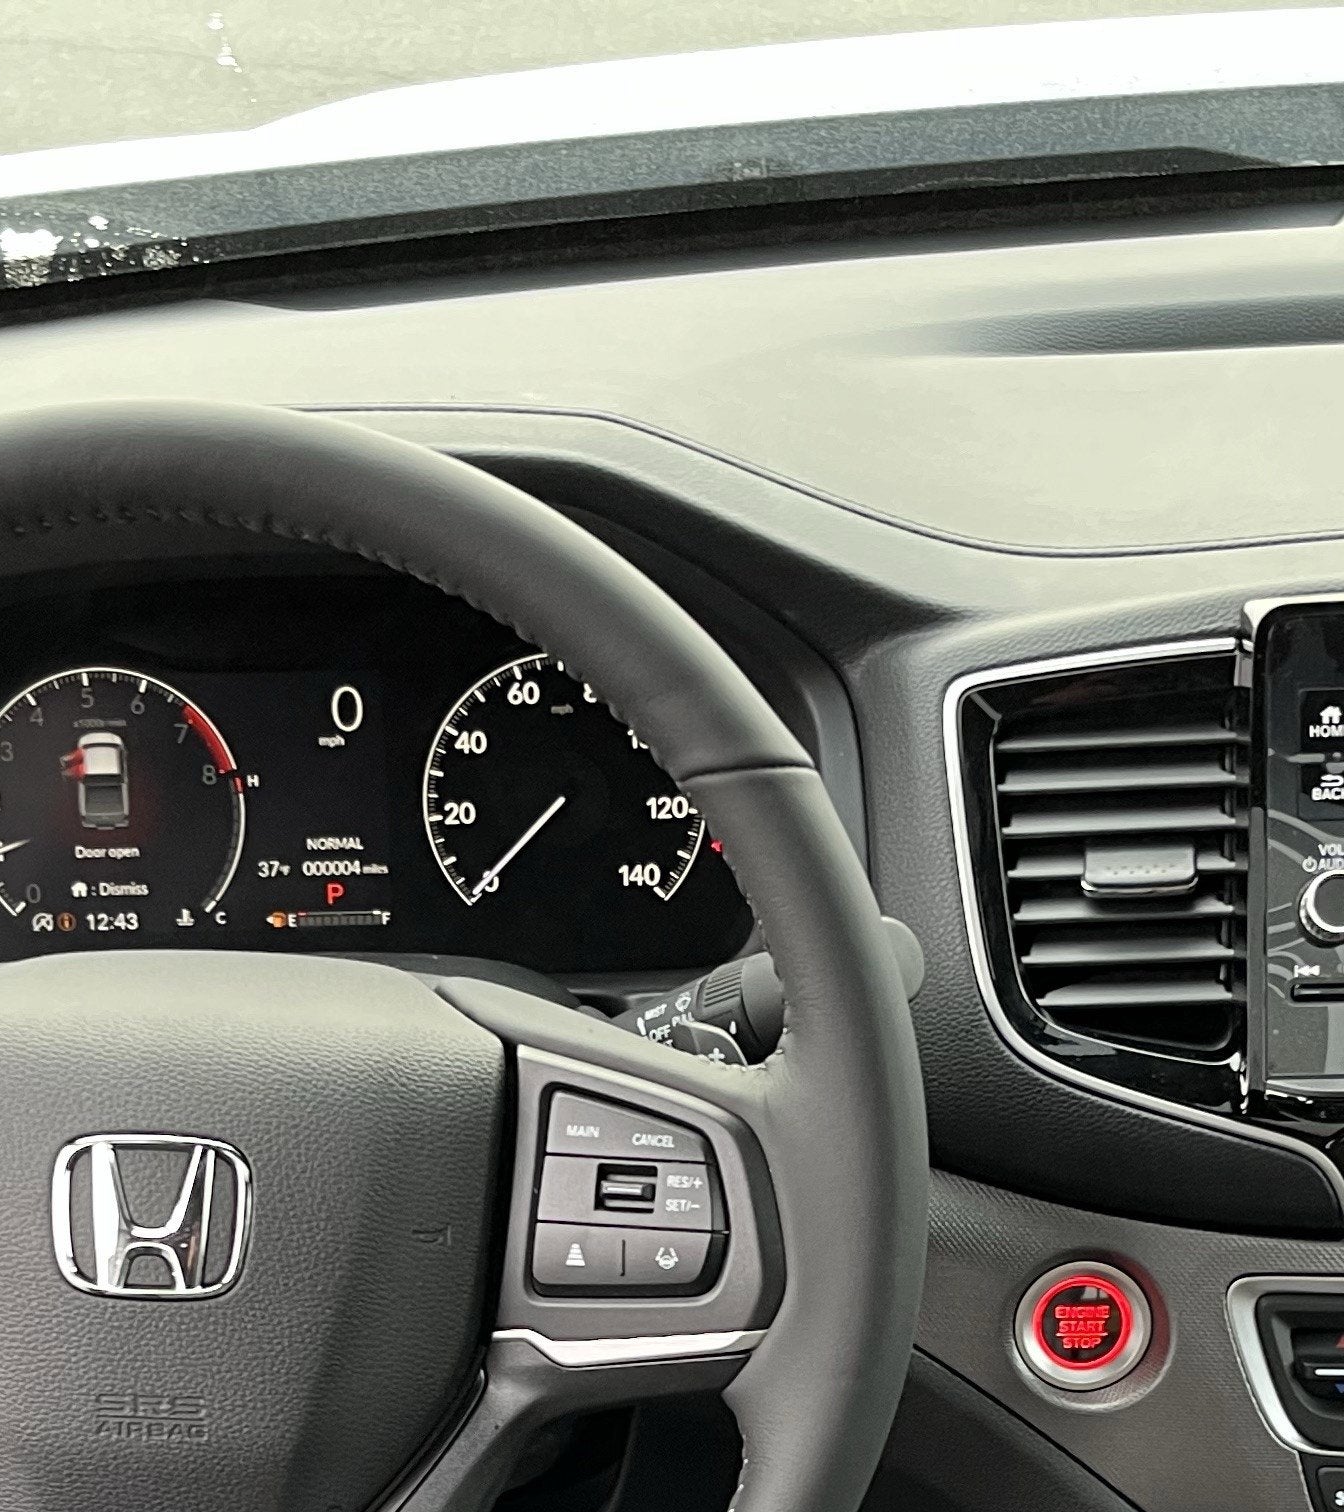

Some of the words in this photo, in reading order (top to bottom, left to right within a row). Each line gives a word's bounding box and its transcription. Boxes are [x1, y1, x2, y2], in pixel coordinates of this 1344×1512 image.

[81, 688, 94, 708] 5
[507, 681, 540, 705] 60
[131, 699, 145, 715] 6
[331, 685, 363, 732] 0
[30, 707, 44, 727] 4
[174, 723, 188, 744] 7
[455, 730, 488, 754] 40
[1, 741, 14, 762] 3
[202, 765, 217, 785] 8
[247, 775, 259, 787] H
[444, 802, 476, 825] 20
[646, 796, 689, 820] 120
[306, 837, 364, 851] NORMAL
[1318, 844, 1344, 857] VOL
[75, 846, 106, 859] Door
[108, 847, 140, 860] open
[302, 860, 361, 876] 000004
[618, 863, 661, 886] 140
[26, 884, 41, 903] 0
[325, 882, 345, 905] P
[86, 913, 139, 931] 12:43
[215, 911, 226, 925] C
[287, 914, 297, 928] E
[381, 911, 391, 926] F
[567, 1125, 600, 1138] MAIN
[632, 1133, 674, 1148] CANCEL
[1055, 1305, 1110, 1319] ENGINE
[1058, 1320, 1106, 1333] START
[1063, 1337, 1102, 1349] STOP
